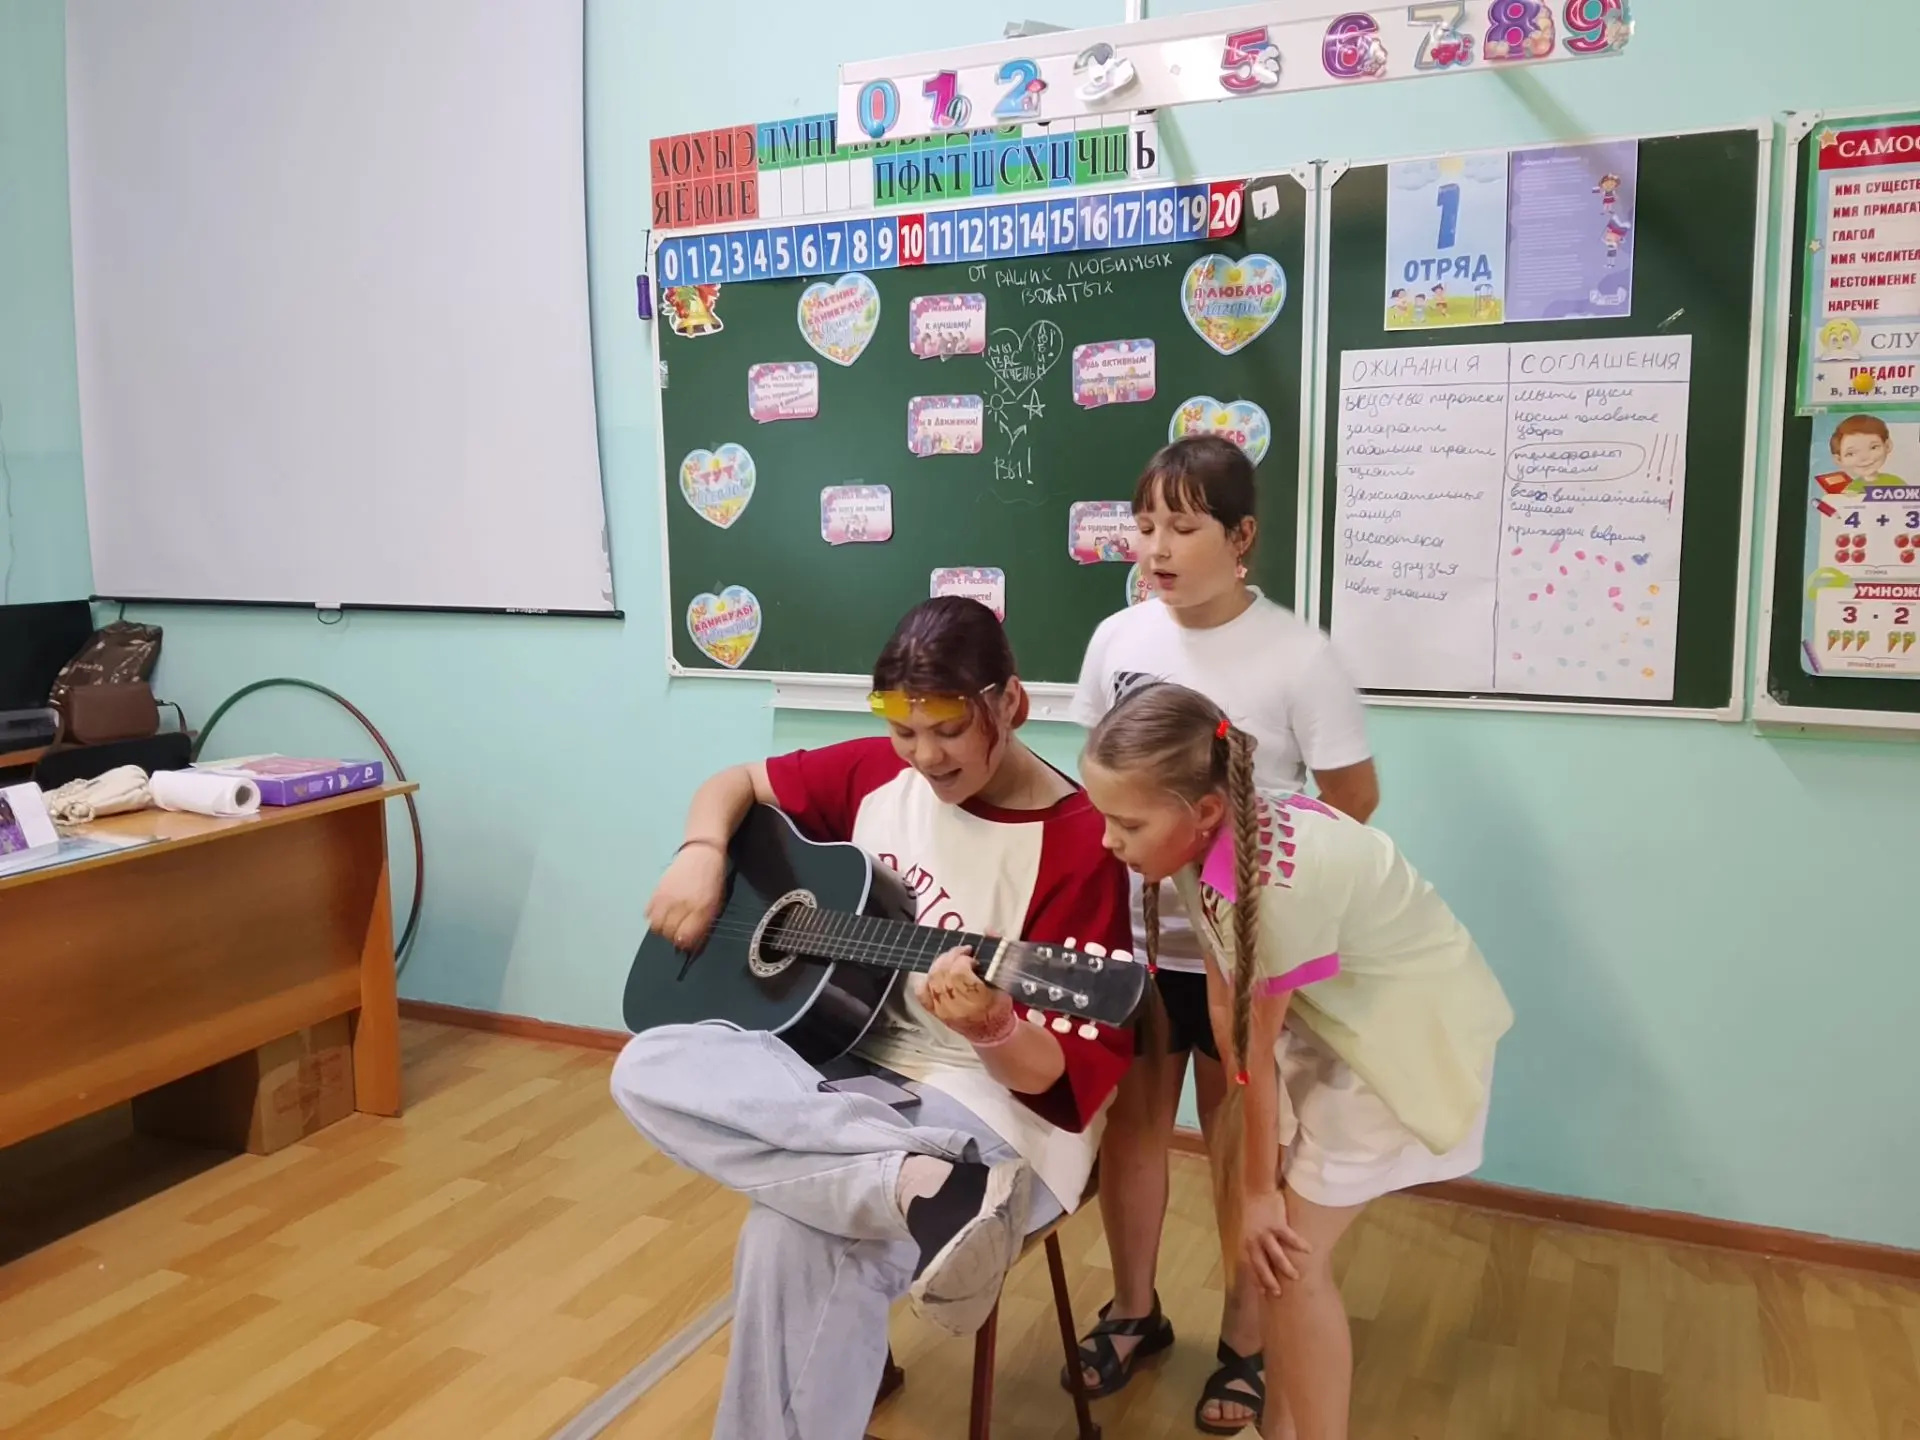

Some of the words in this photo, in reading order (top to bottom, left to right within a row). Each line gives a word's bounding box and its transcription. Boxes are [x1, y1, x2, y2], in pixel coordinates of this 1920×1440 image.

[857, 78, 900, 138] 0
[923, 70, 966, 130] 1
[994, 58, 1046, 117] 2
[1220, 25, 1281, 93] 5
[1322, 12, 1388, 80] 6
[1408, 0, 1474, 69] 7
[1484, 0, 1555, 60] 8
[1562, 0, 1628, 56] 9
[1835, 183, 1861, 196] ИМЯ
[1436, 183, 1460, 249] 1
[1833, 205, 1859, 218] ИМЯ
[664, 249, 678, 281] 0
[687, 246, 699, 278] 1
[709, 244, 722, 277] 2
[731, 241, 744, 275] 3
[754, 239, 767, 272] 4
[777, 236, 790, 271] 5
[801, 234, 817, 268] 6
[826, 232, 841, 267] 7
[853, 229, 868, 264] 8
[878, 226, 893, 262] 9
[901, 223, 922, 259] 10
[928, 221, 952, 256] 11
[959, 217, 983, 254] 12
[989, 214, 1013, 251] 13
[1020, 211, 1046, 248] 14
[1051, 208, 1075, 245] 15
[1080, 204, 1108, 242] 16
[1113, 201, 1141, 239] 17
[1149, 198, 1174, 236] 18
[1179, 195, 1208, 234] 19
[1210, 190, 1241, 230] 20
[1832, 227, 1875, 242] ГЛАГОЛ
[1831, 252, 1856, 265] ИМЯ
[968, 265, 989, 283] ОТ
[1067, 253, 1173, 280] ЛЮБИМЫХ
[1403, 254, 1492, 283] ОТРЯД
[1830, 273, 1917, 289] МЕСТОИМЕНИЕ
[1828, 299, 1880, 312] НАРЕЧИЕ
[1871, 332, 1920, 349] СЛУ
[1353, 355, 1480, 382] ОЖИДАНИЯ
[1520, 350, 1681, 374] СОГЛАШЕНИЯ
[1429, 394, 1504, 410] пирожки
[1585, 387, 1633, 407] руки
[1574, 406, 1660, 424] головные
[1346, 421, 1447, 441] загорать
[1517, 423, 1564, 442] уборы
[1346, 438, 1423, 456] побольше
[1430, 446, 1497, 459] играть
[1514, 448, 1623, 466] телефоны
[1510, 502, 1575, 518] слушаем
[1844, 511, 1861, 529] 4
[1905, 511, 1920, 529] 3
[1343, 528, 1446, 549] дискотека
[1391, 561, 1460, 580] друзья
[1385, 586, 1450, 601] знания
[1858, 586, 1920, 597] УМНОЖ
[1843, 606, 1858, 624] 3
[1894, 607, 1910, 625] 2
